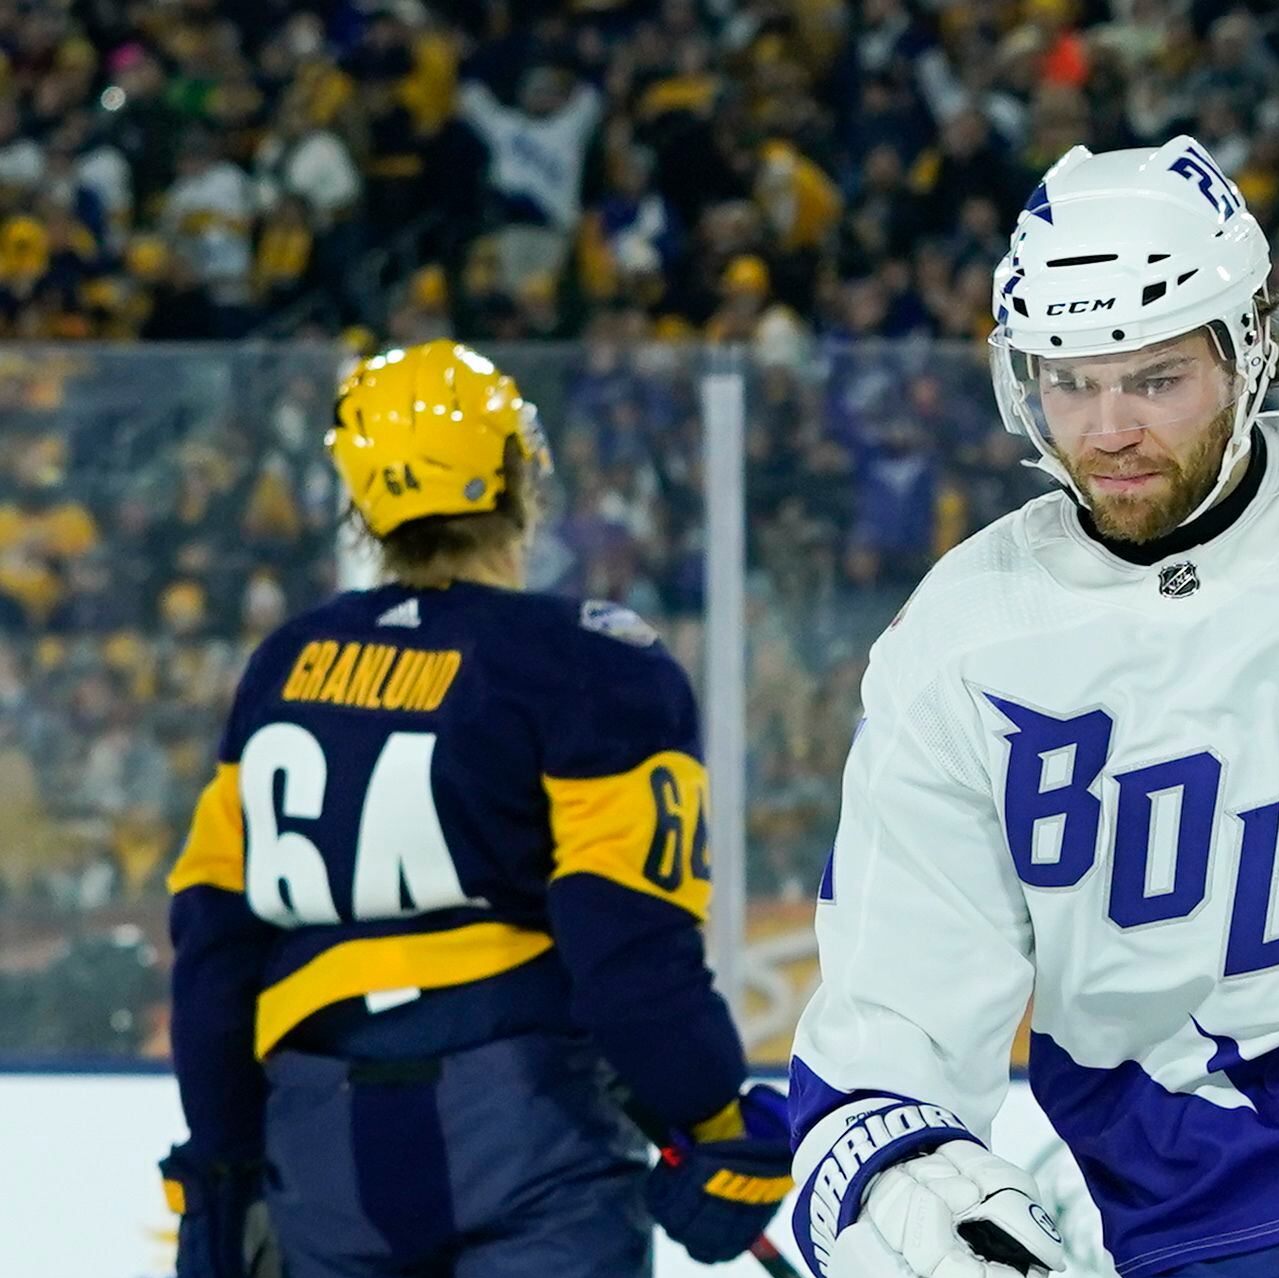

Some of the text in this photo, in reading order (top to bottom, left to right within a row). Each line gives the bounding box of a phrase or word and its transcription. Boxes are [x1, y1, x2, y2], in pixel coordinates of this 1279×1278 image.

[1046, 297, 1117, 317] CCM
[383, 463, 421, 496] 64
[281, 640, 462, 712] GRANLUND
[240, 722, 492, 927] 64
